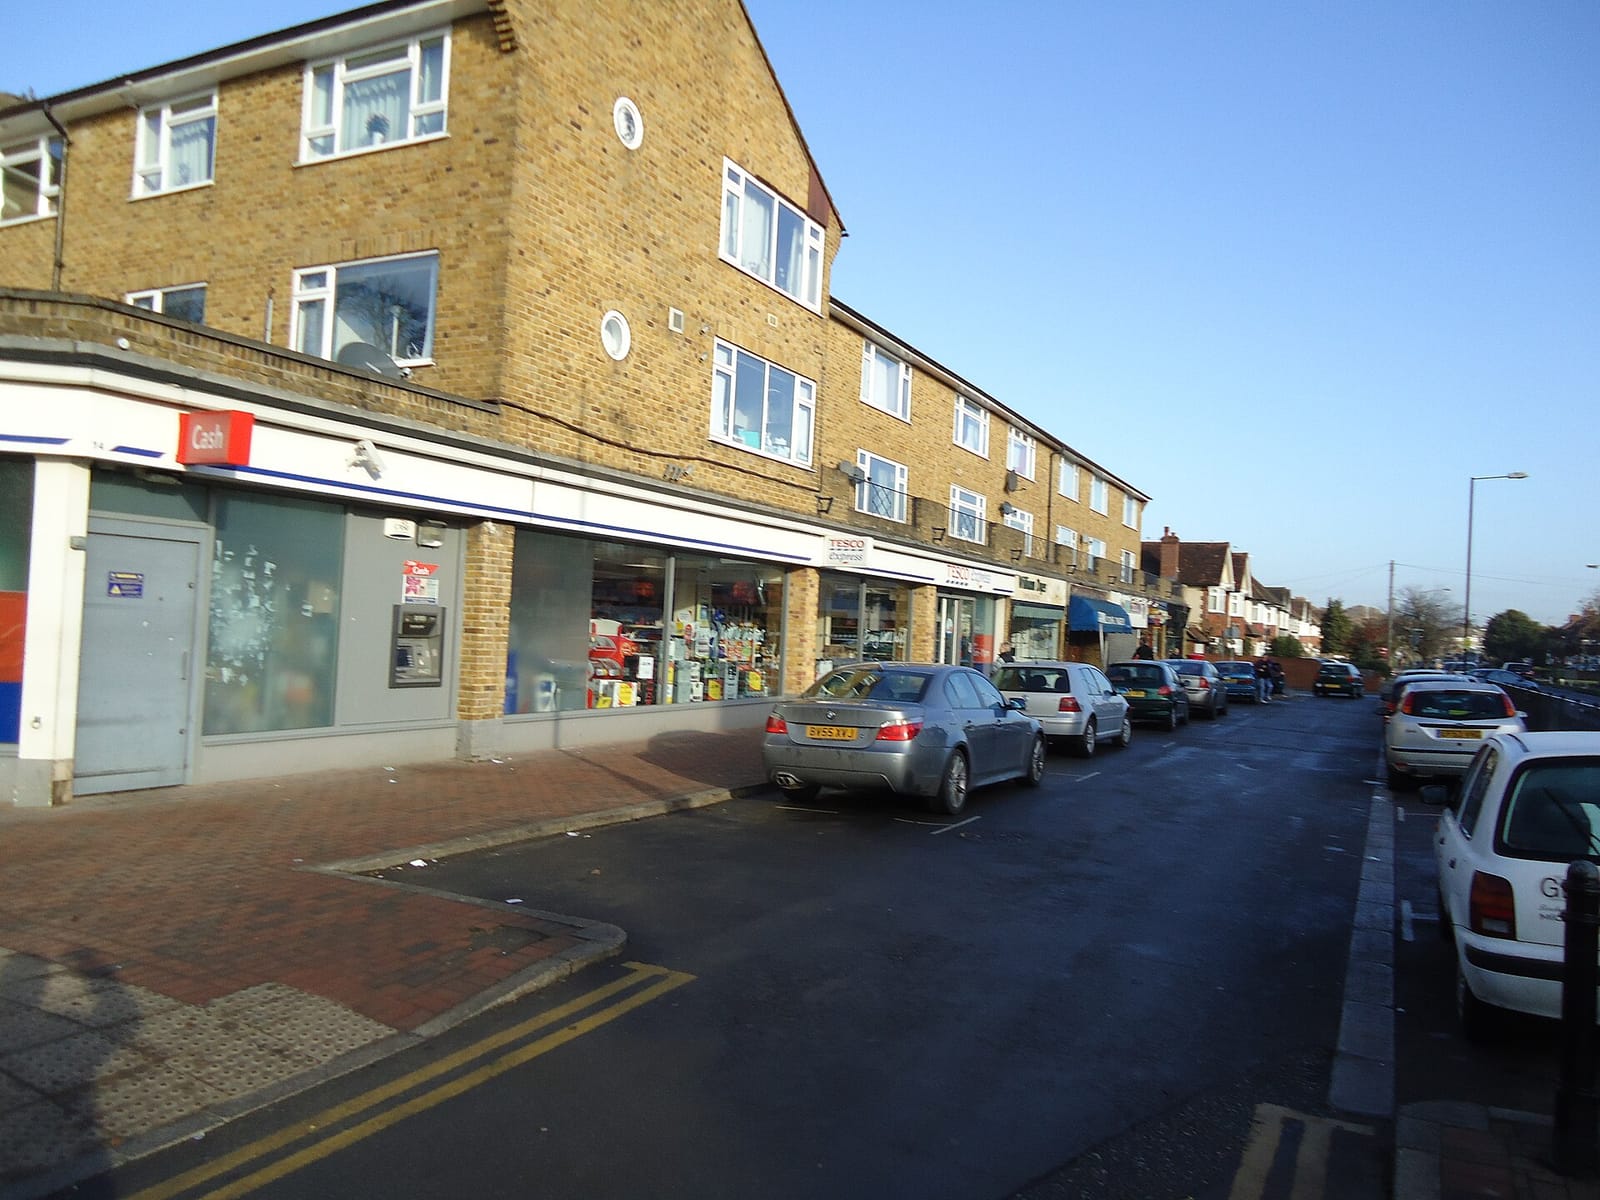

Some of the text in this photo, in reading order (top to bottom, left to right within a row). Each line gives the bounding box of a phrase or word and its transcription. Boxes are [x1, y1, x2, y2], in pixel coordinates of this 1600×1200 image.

[191, 424, 224, 450] Cash
[829, 539, 865, 548] TESCO
[828, 551, 864, 563] express
[946, 564, 970, 581] TESCO
